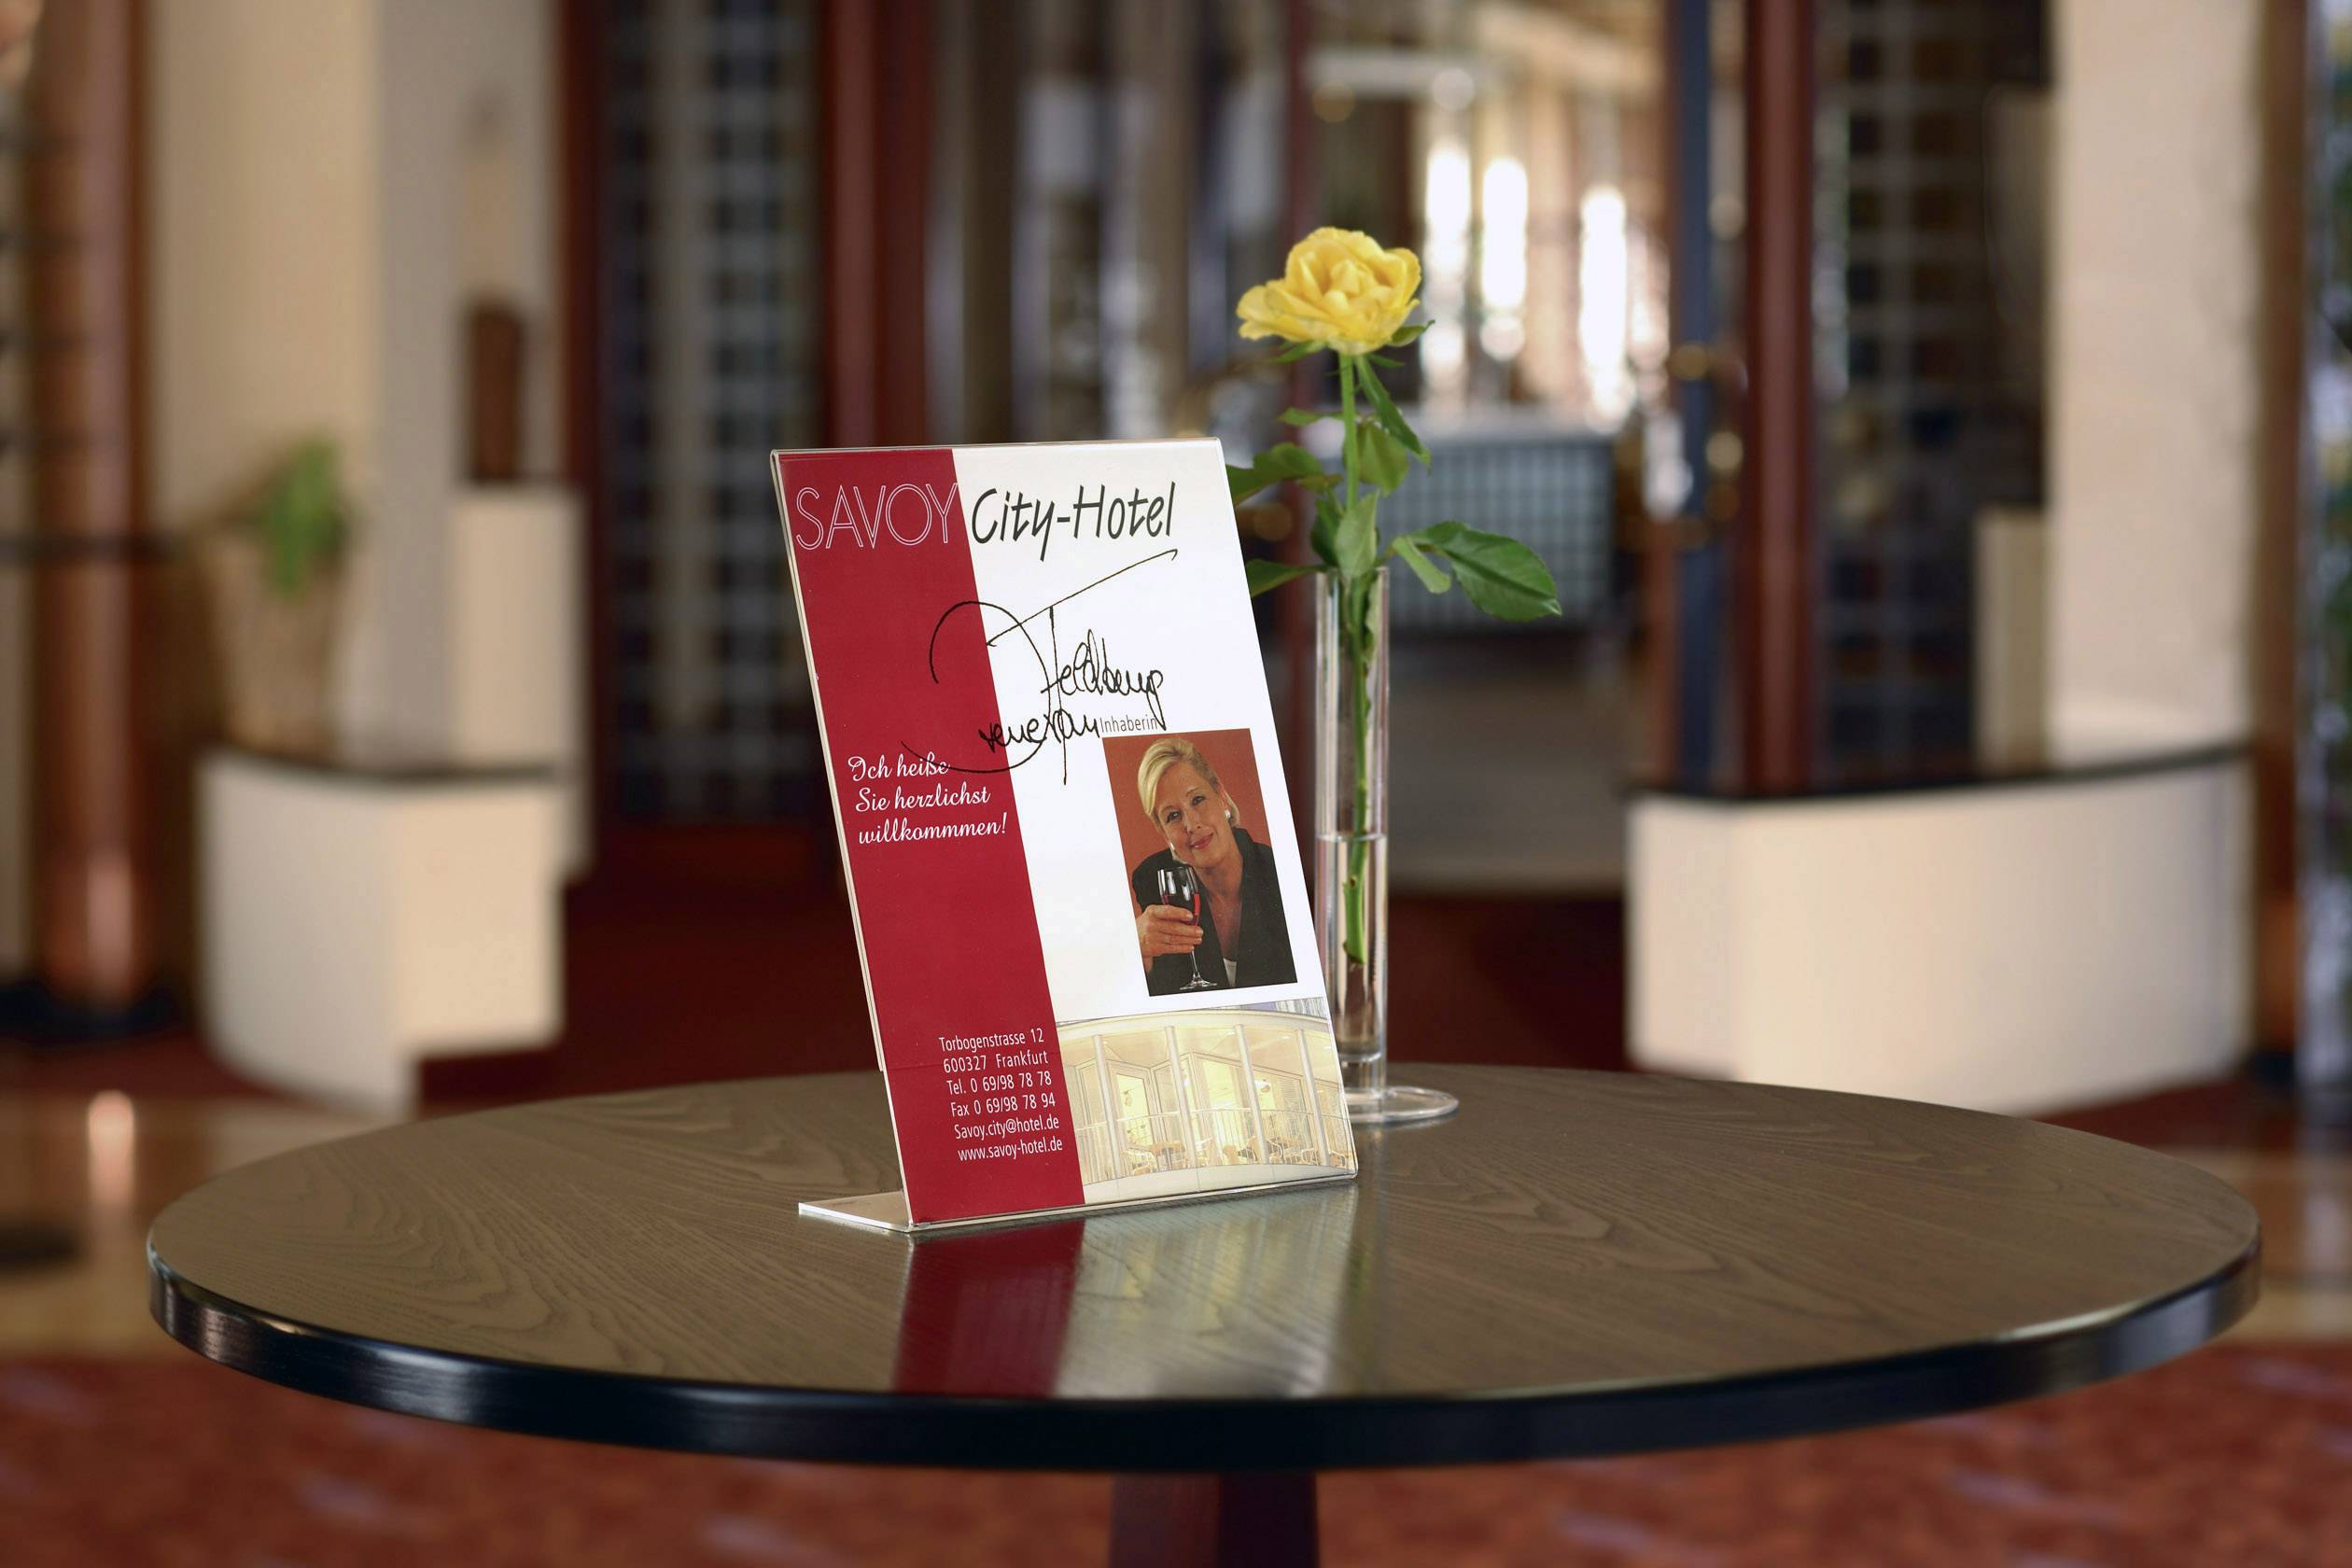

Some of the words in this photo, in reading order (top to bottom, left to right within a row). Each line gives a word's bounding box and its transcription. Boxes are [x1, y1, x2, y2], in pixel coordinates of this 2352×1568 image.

[795, 483, 959, 550] SAVOY
[971, 482, 1176, 562] City-Hotel
[1099, 716, 1158, 733] Inhaberin
[847, 754, 892, 782] Ich
[896, 750, 951, 777] heiße
[855, 787, 889, 812] Sie
[894, 781, 991, 809] herzlichst
[939, 1033, 1026, 1053] Torbogenstrasse
[1030, 1028, 1044, 1043] 12
[943, 1055, 987, 1073] 600327
[996, 1049, 1048, 1069] Frankfurt
[946, 1078, 967, 1096] Tel.
[970, 1077, 978, 1093] 0
[982, 1073, 1015, 1092] 69/98
[1018, 1072, 1033, 1088] 78
[1037, 1071, 1052, 1086] 78
[950, 1101, 970, 1118] Fax
[973, 1099, 981, 1114] 0
[986, 1096, 1018, 1113] 69/98
[1022, 1094, 1037, 1110] 78
[1041, 1092, 1056, 1109] 94
[954, 1114, 1059, 1141] Savoy.city@hotel.de
[958, 1136, 1063, 1161] www.savoy-hotel.de
